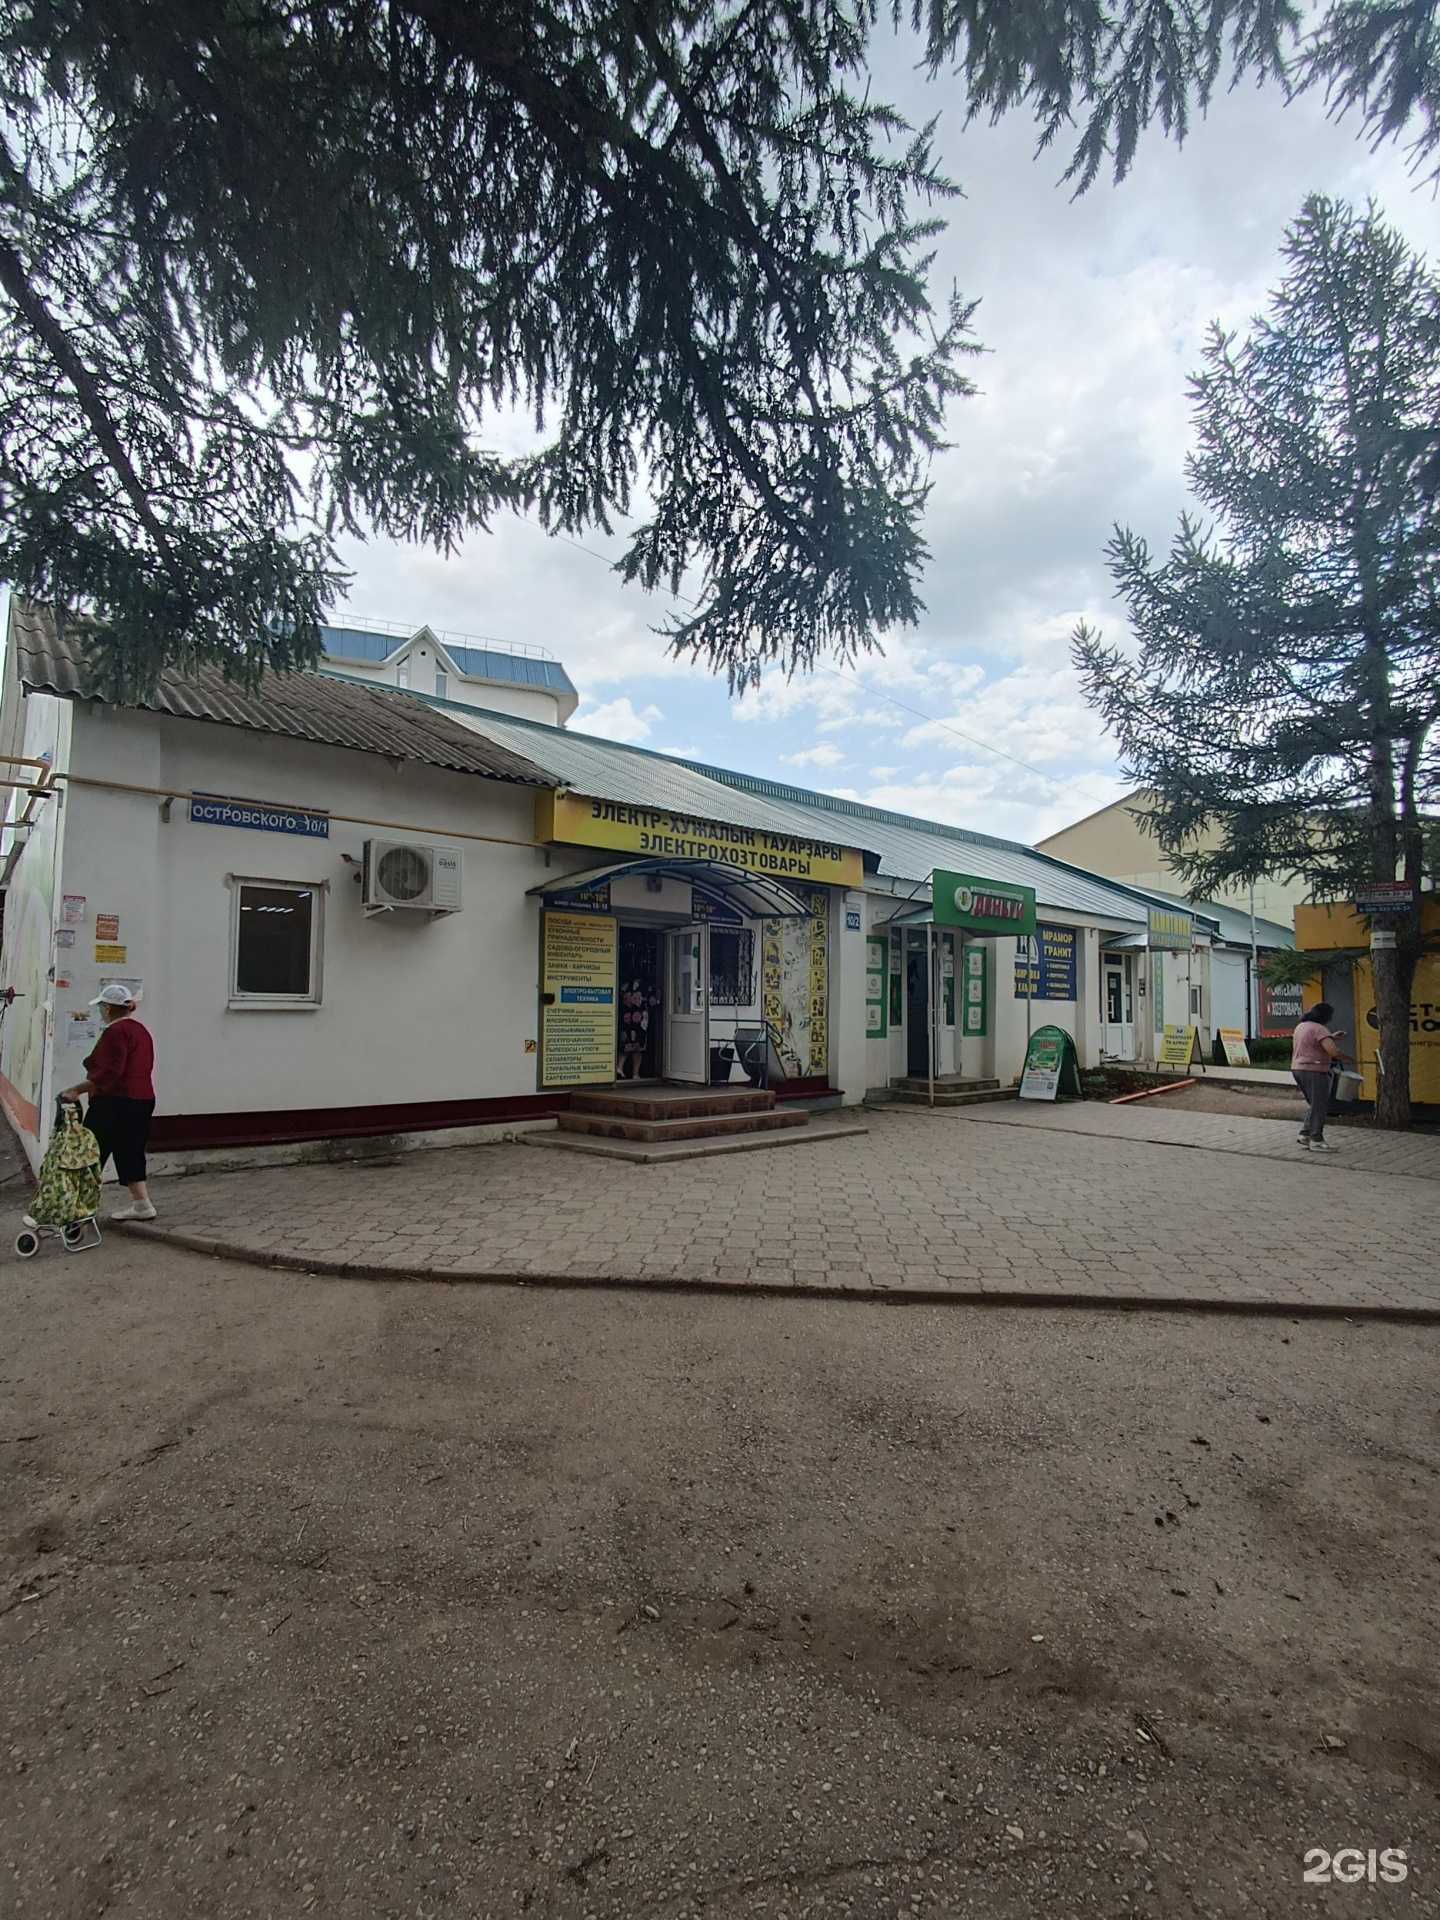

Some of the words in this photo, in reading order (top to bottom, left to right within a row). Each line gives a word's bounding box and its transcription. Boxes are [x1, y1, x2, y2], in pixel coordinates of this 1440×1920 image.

[640, 832, 811, 875] ЭЛЕКТРОХОЗТОВАРЫ
[1042, 929, 1073, 944] МРАМОР
[1043, 945, 1073, 958] ГРАНИТ
